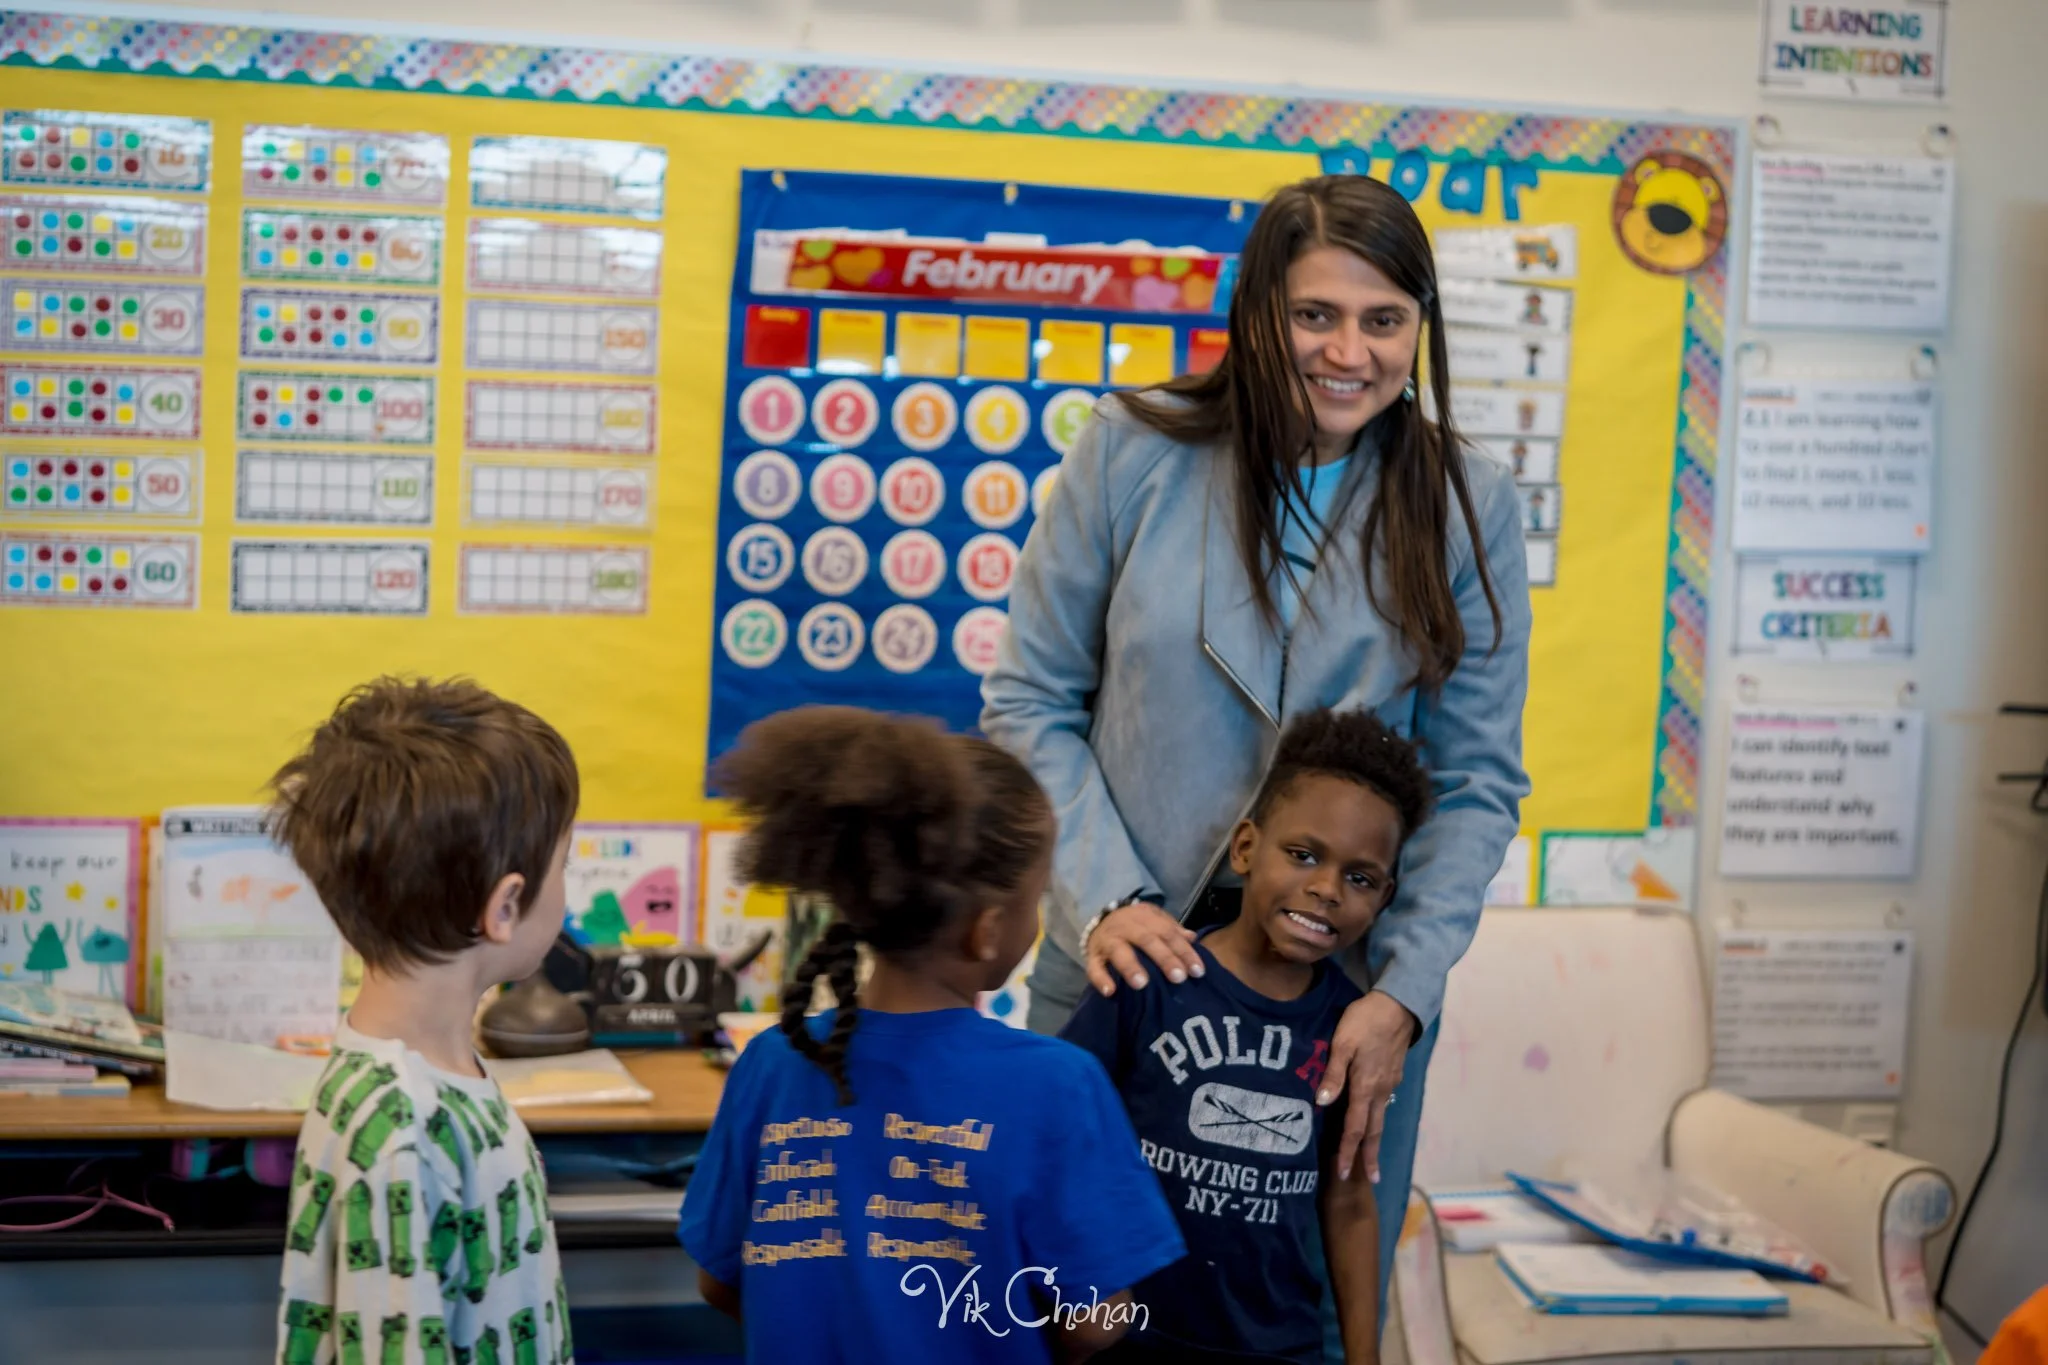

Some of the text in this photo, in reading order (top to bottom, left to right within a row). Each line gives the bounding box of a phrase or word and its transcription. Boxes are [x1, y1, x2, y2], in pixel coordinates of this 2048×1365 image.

[1790, 6, 1921, 40] LEARNING
[1775, 43, 1932, 78] INTENTIONS
[902, 250, 1113, 304] February
[154, 309, 184, 331] 30
[151, 392, 181, 414] 40
[381, 400, 422, 422] 100
[834, 393, 856, 431] 2
[916, 399, 936, 435] 3
[985, 402, 1008, 436] 4
[1817, 410, 1884, 433] learning
[1885, 409, 1920, 429] how
[1813, 439, 1884, 456] hundred
[148, 474, 179, 495] 50
[382, 477, 418, 499] 110
[760, 464, 777, 501] 8
[835, 470, 854, 506] 9
[902, 475, 926, 509] 10
[984, 479, 1008, 513] 11
[1821, 490, 1850, 509] and
[144, 561, 176, 583] 60
[745, 539, 776, 575] 15
[819, 540, 851, 577] 16
[899, 546, 930, 582] 17
[1774, 571, 1885, 600] SUCCESS
[736, 616, 771, 652] 22
[1760, 612, 1892, 641] CRITERIA
[1742, 739, 1774, 754] can
[1779, 737, 1848, 759] identify
[1853, 740, 1891, 756] text
[1729, 766, 1845, 786] features and
[1726, 797, 1875, 819] understand why
[1724, 825, 1903, 848] they are important.
[627, 1008, 677, 1025] APRIL
[1150, 1015, 1292, 1086] POLO
[1141, 1139, 1319, 1194] ROWING CLUB
